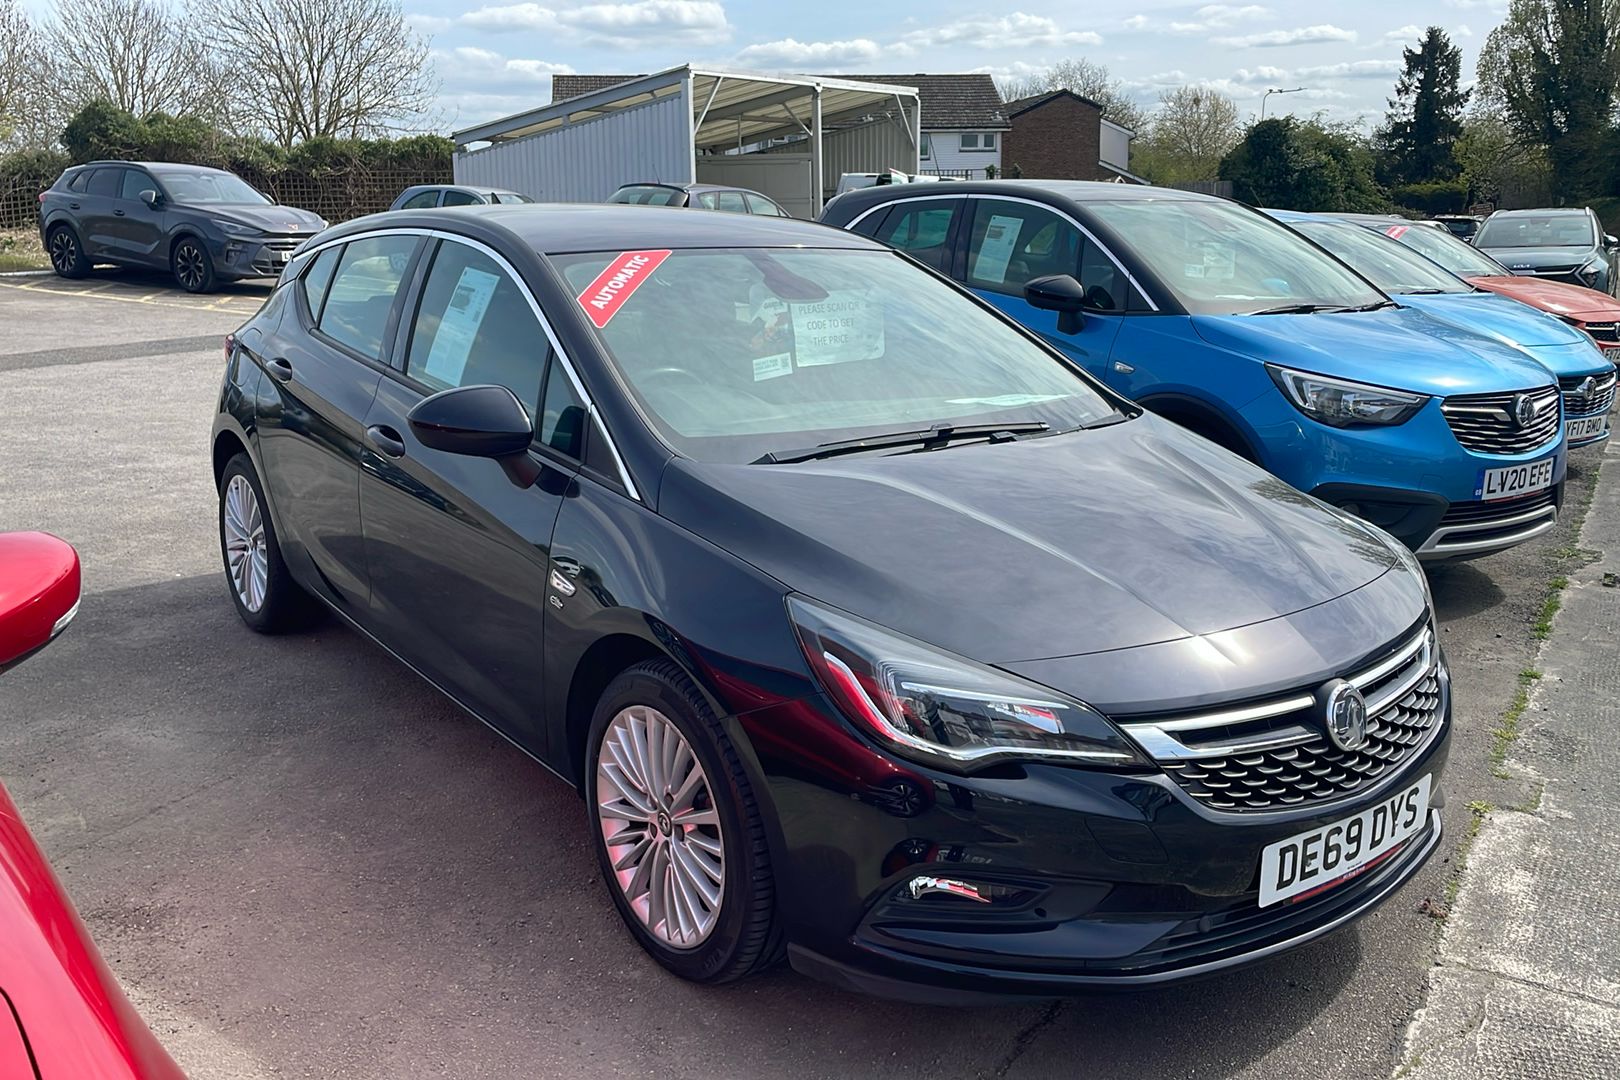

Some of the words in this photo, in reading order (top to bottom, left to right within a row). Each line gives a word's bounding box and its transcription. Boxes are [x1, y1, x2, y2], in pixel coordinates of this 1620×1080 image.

[590, 255, 650, 310] AUTOMATIC
[799, 303, 826, 315] PLEASE
[826, 302, 847, 313] SCAN
[807, 319, 827, 331] CODE
[829, 318, 840, 328] TO
[840, 318, 854, 328] GET
[813, 335, 828, 347] THE
[828, 334, 849, 345] PRICE
[1566, 420, 1586, 436] YF17
[1487, 467, 1527, 495] LV20
[1529, 461, 1551, 487] EFE
[1275, 816, 1364, 891] DE69
[1369, 786, 1420, 851] DYS
